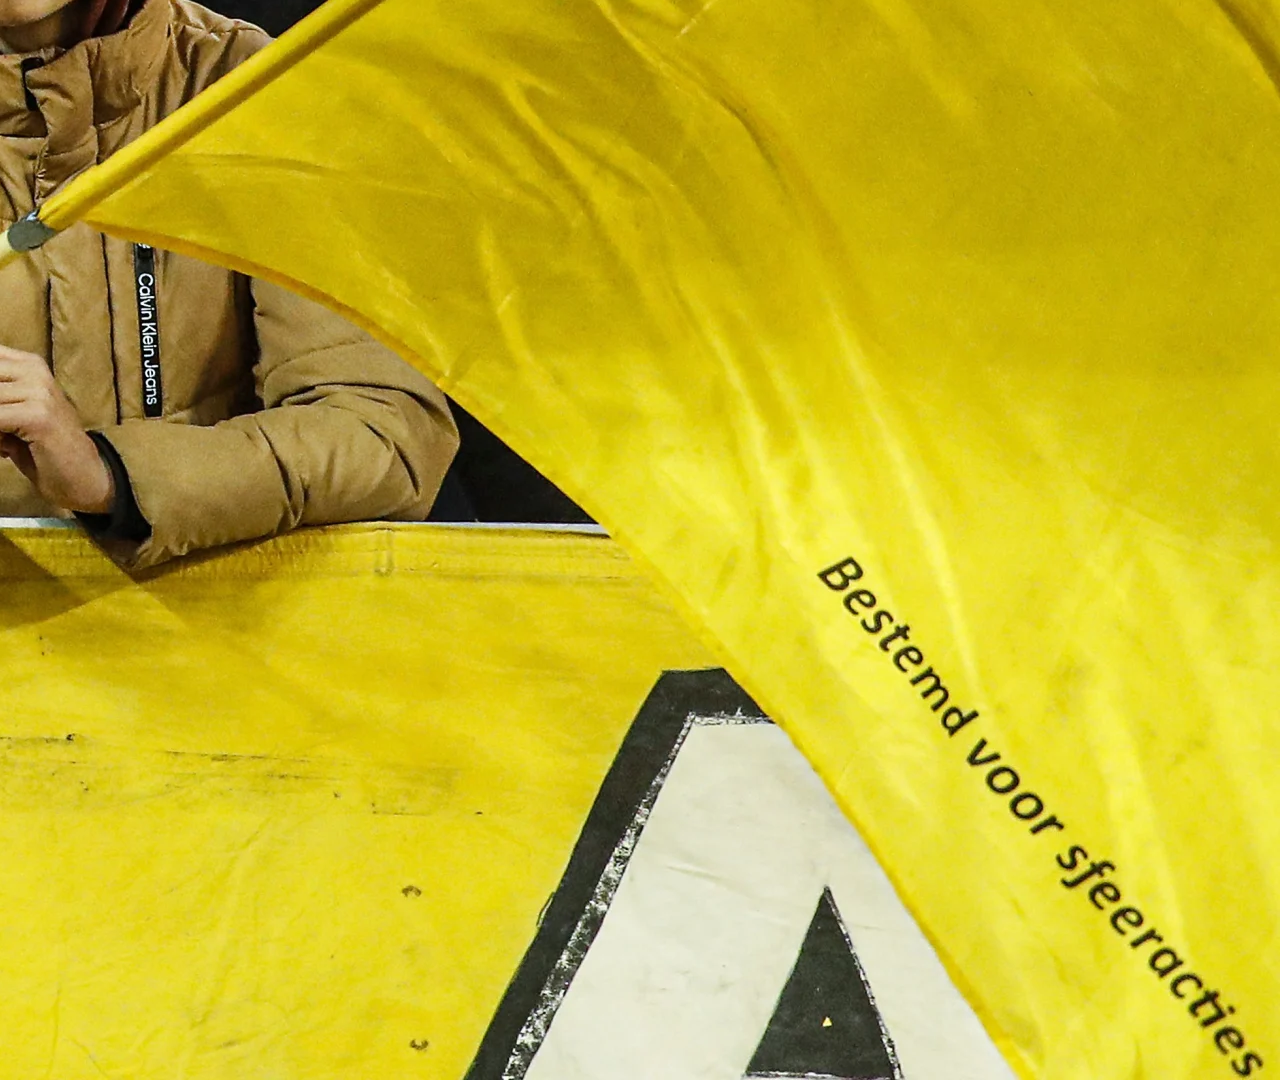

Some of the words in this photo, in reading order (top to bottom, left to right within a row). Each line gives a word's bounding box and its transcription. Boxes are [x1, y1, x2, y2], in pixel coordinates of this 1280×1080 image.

[138, 273, 155, 321] Calvin
[141, 322, 157, 358] Klein
[144, 359, 158, 406] Jeans
[816, 555, 980, 739] Bestemd
[965, 737, 1065, 836] voor
[1054, 843, 1264, 1079] sfeeracties
